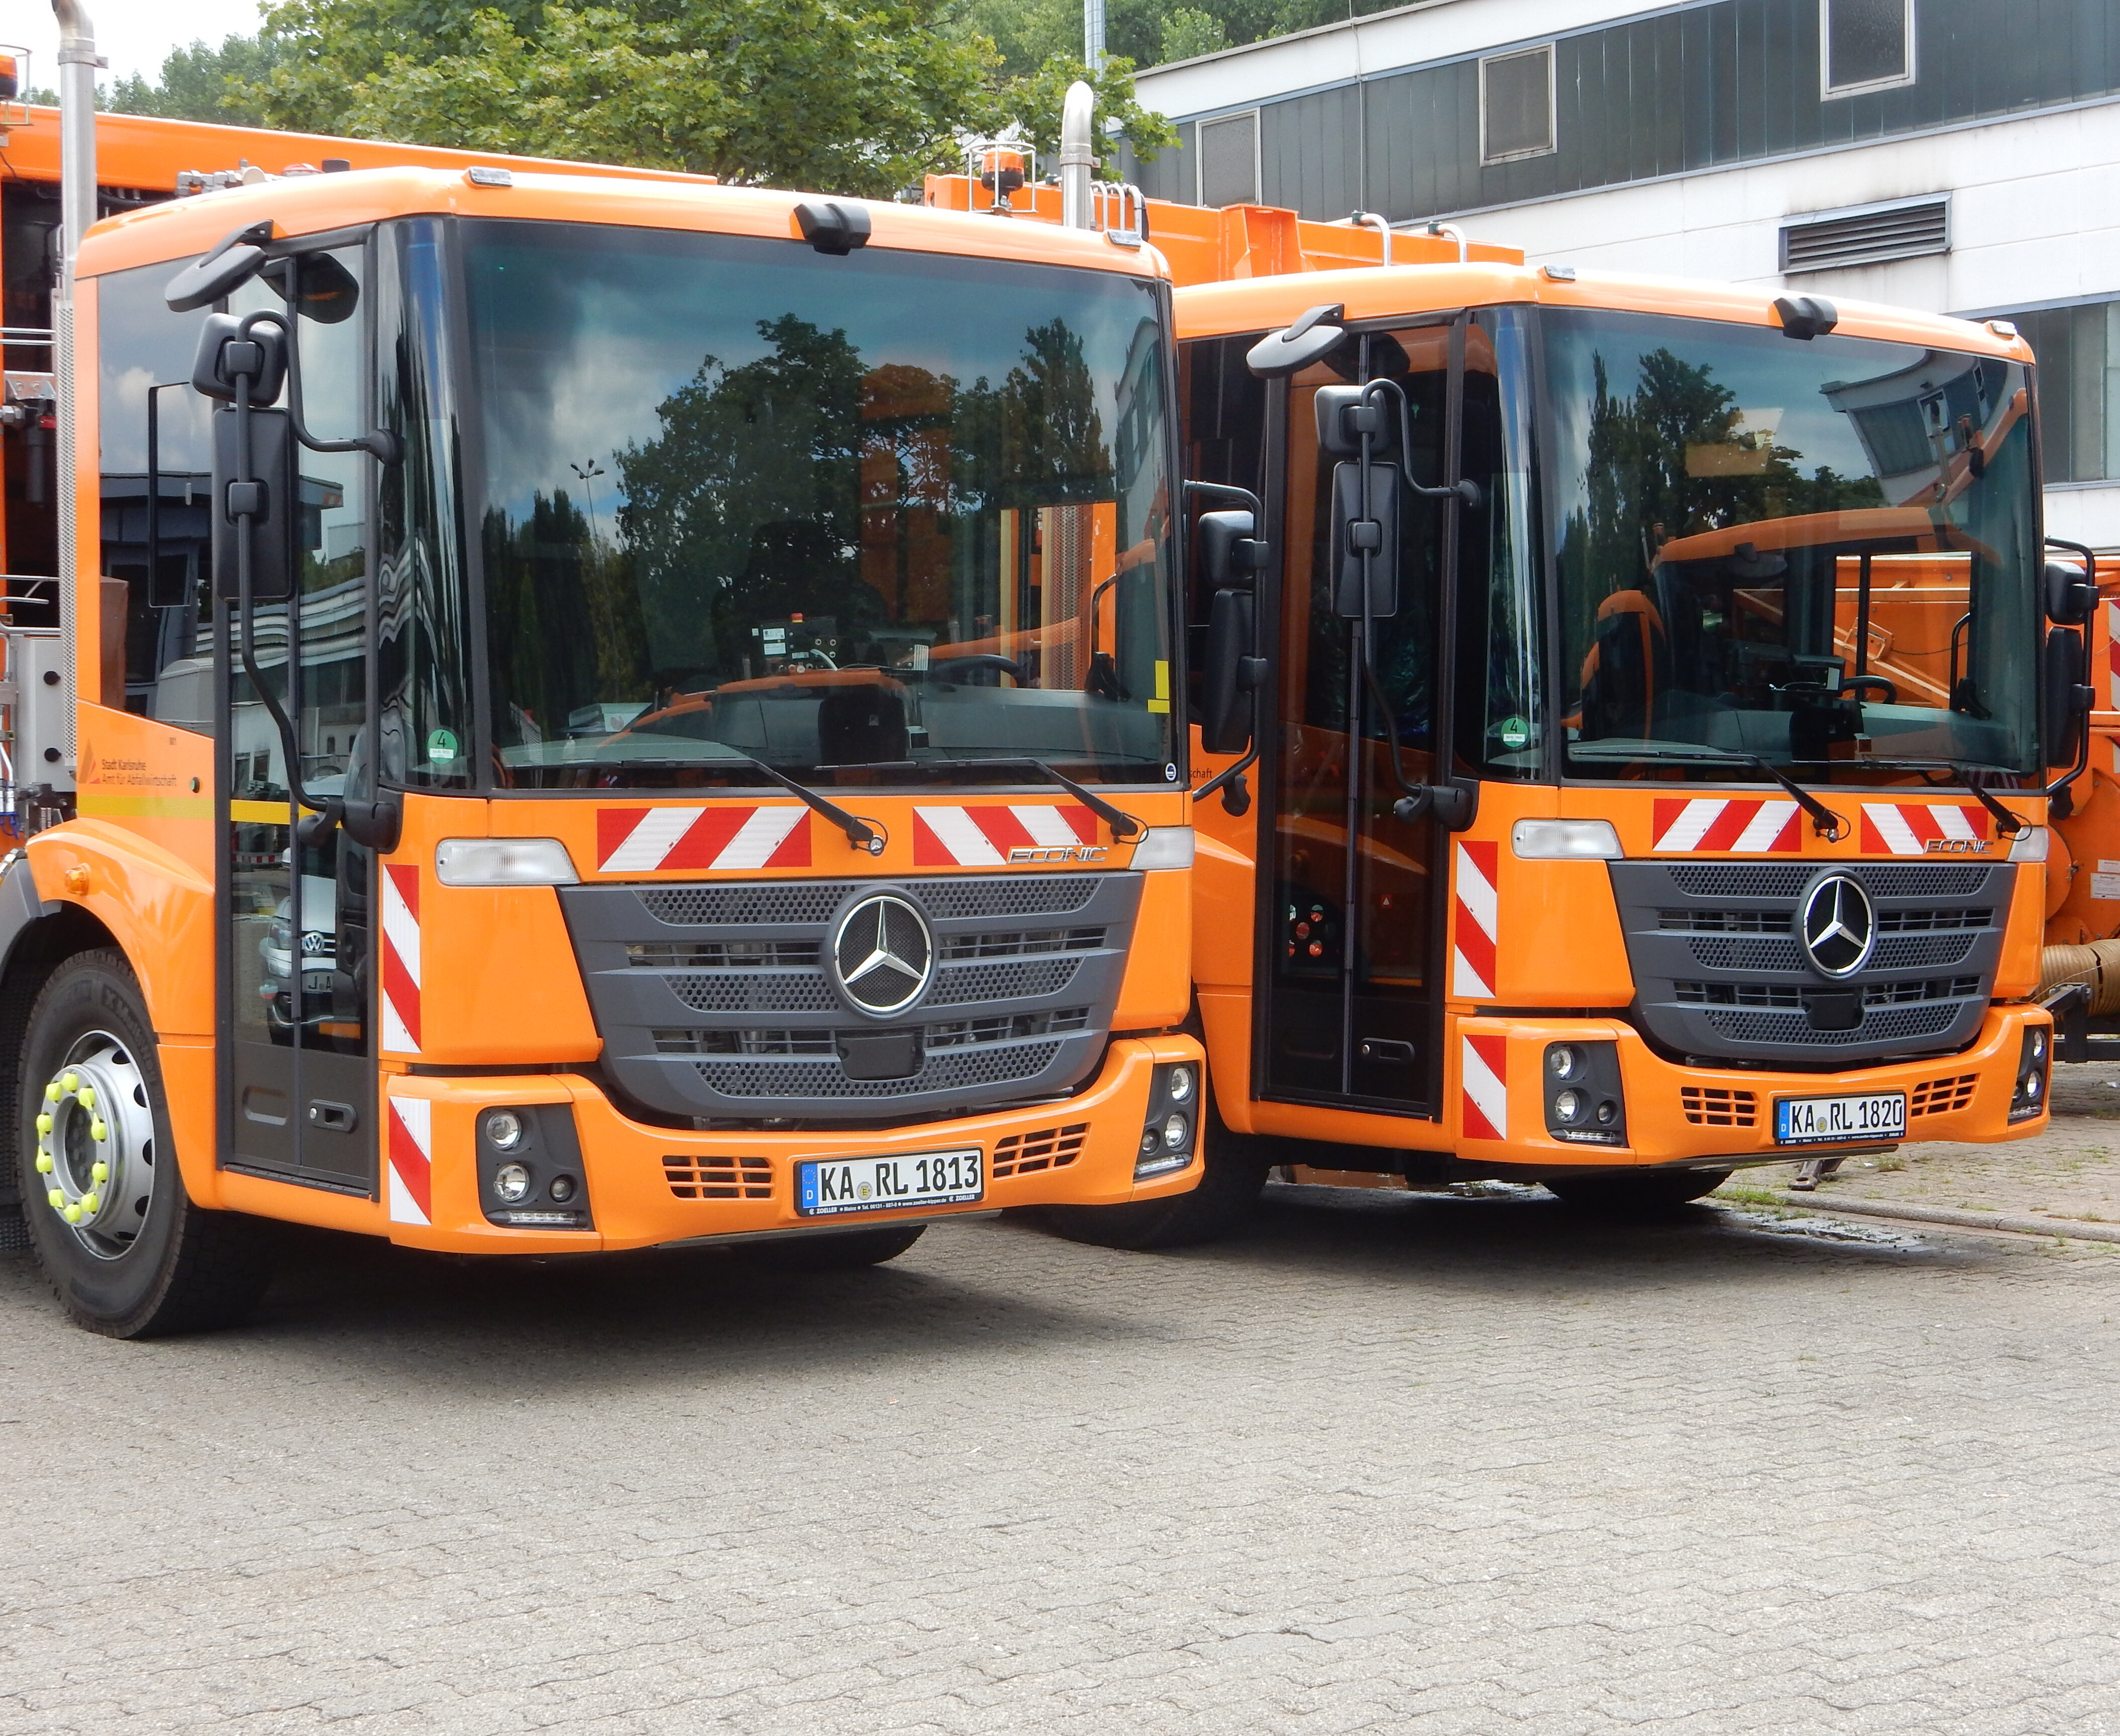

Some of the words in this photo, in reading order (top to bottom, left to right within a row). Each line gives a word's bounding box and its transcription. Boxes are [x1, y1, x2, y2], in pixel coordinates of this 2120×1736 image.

[1510, 720, 1517, 733] 4
[437, 732, 446, 747] 4
[1924, 840, 1994, 853] ECONIC
[1008, 846, 1109, 864] ECONIC
[1792, 1105, 1814, 1133] KA
[1830, 1103, 1852, 1131] RL
[1859, 1099, 1902, 1129] 1820
[1781, 1124, 1786, 1132] D
[821, 1166, 854, 1201] KA
[875, 1162, 908, 1196] RL
[916, 1155, 978, 1193] 1813
[806, 1189, 813, 1200] D
[817, 1206, 837, 1214] ZOELLER
